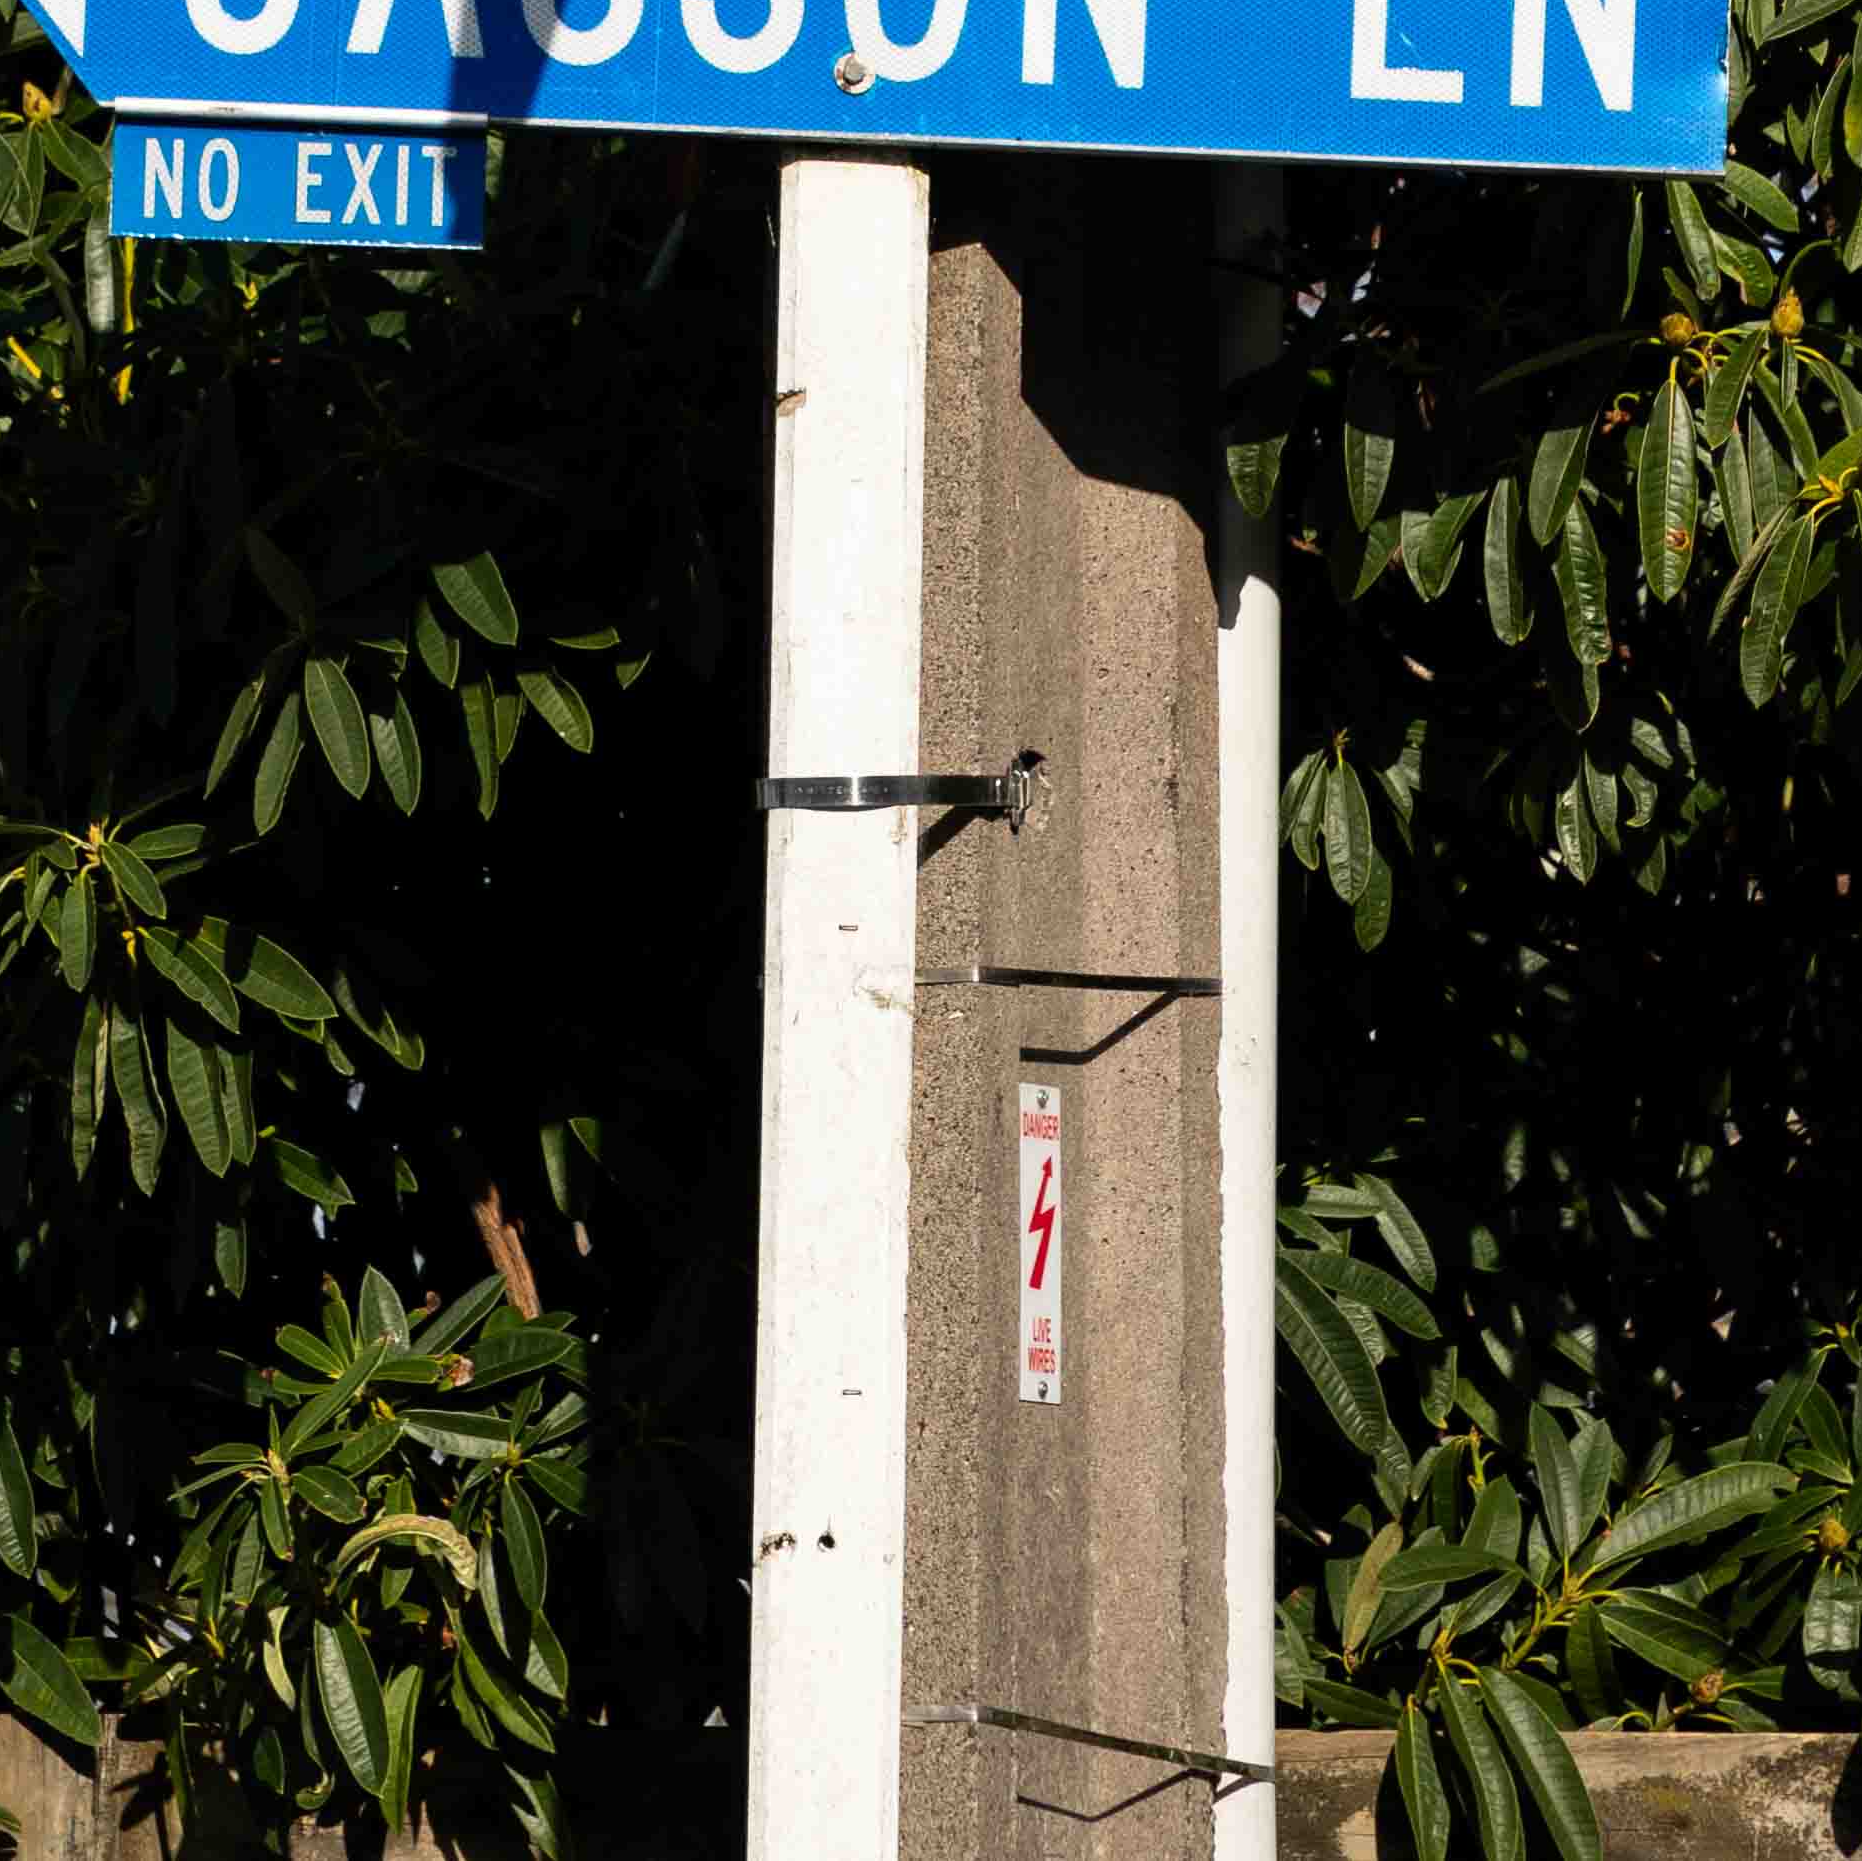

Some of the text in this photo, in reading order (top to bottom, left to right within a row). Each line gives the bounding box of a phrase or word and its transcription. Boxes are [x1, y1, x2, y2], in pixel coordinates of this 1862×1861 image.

[143, 138, 457, 227] NO EXIT
[1023, 1112, 1060, 1141] DANGER
[1032, 1317, 1052, 1343] LIVE
[1028, 1346, 1056, 1374] WIRES
